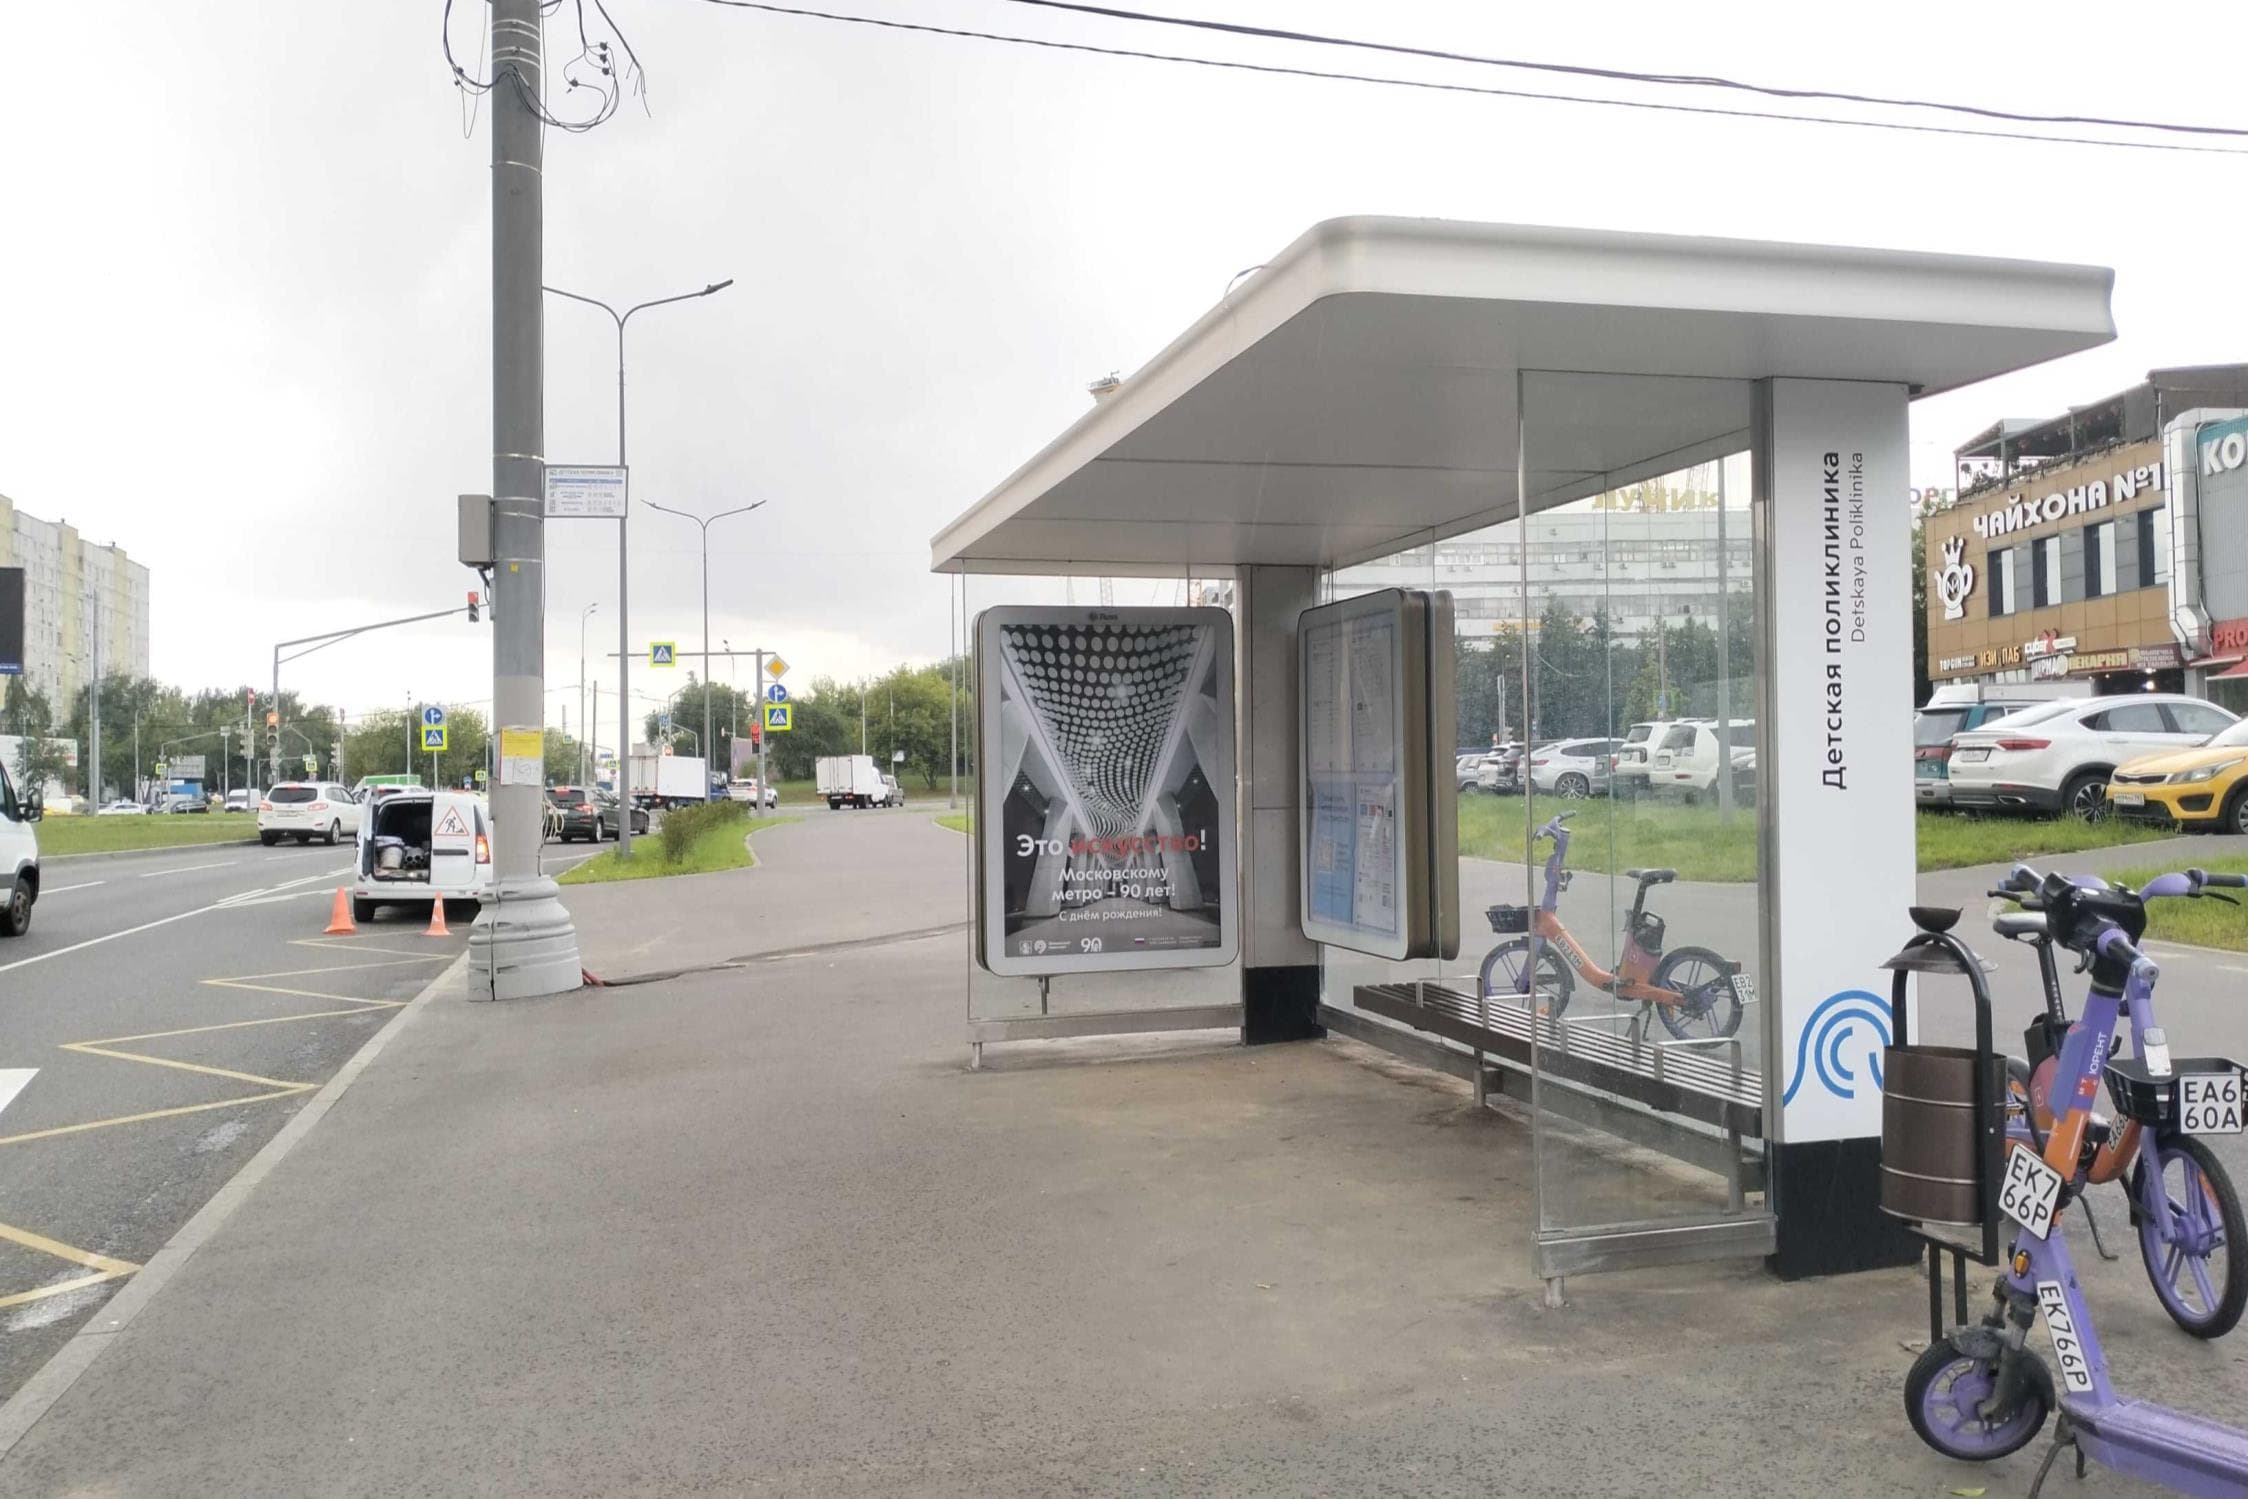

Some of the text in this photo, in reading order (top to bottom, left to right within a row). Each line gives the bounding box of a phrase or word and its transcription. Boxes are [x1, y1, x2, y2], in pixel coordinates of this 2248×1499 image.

[2203, 429, 2248, 476] КО
[1973, 462, 2161, 539] ЧАЙХОНА №1
[1848, 452, 1867, 642] Detskaya Poliklinika
[1823, 452, 1847, 790] Детская поликлиника
[2002, 645, 2020, 664] ПАБ
[2069, 652, 2128, 669] ПЕКАРНЯ
[1016, 829, 1206, 862] Это искусство!
[1052, 889, 1102, 903] метро
[1120, 884, 1141, 898] 90
[1144, 882, 1176, 898] лет!
[1058, 867, 1169, 882] Московскому
[1059, 907, 1162, 923] С днём рождения!
[2088, 1031, 2107, 1075] ЮРЕНТ
[2184, 1080, 2237, 1103] ЕА6
[2185, 1106, 2239, 1130] 60А
[2011, 1152, 2057, 1201] ЕК7
[2003, 1184, 2048, 1226] 66Р
[2039, 1286, 2088, 1386] ЕК766Р
